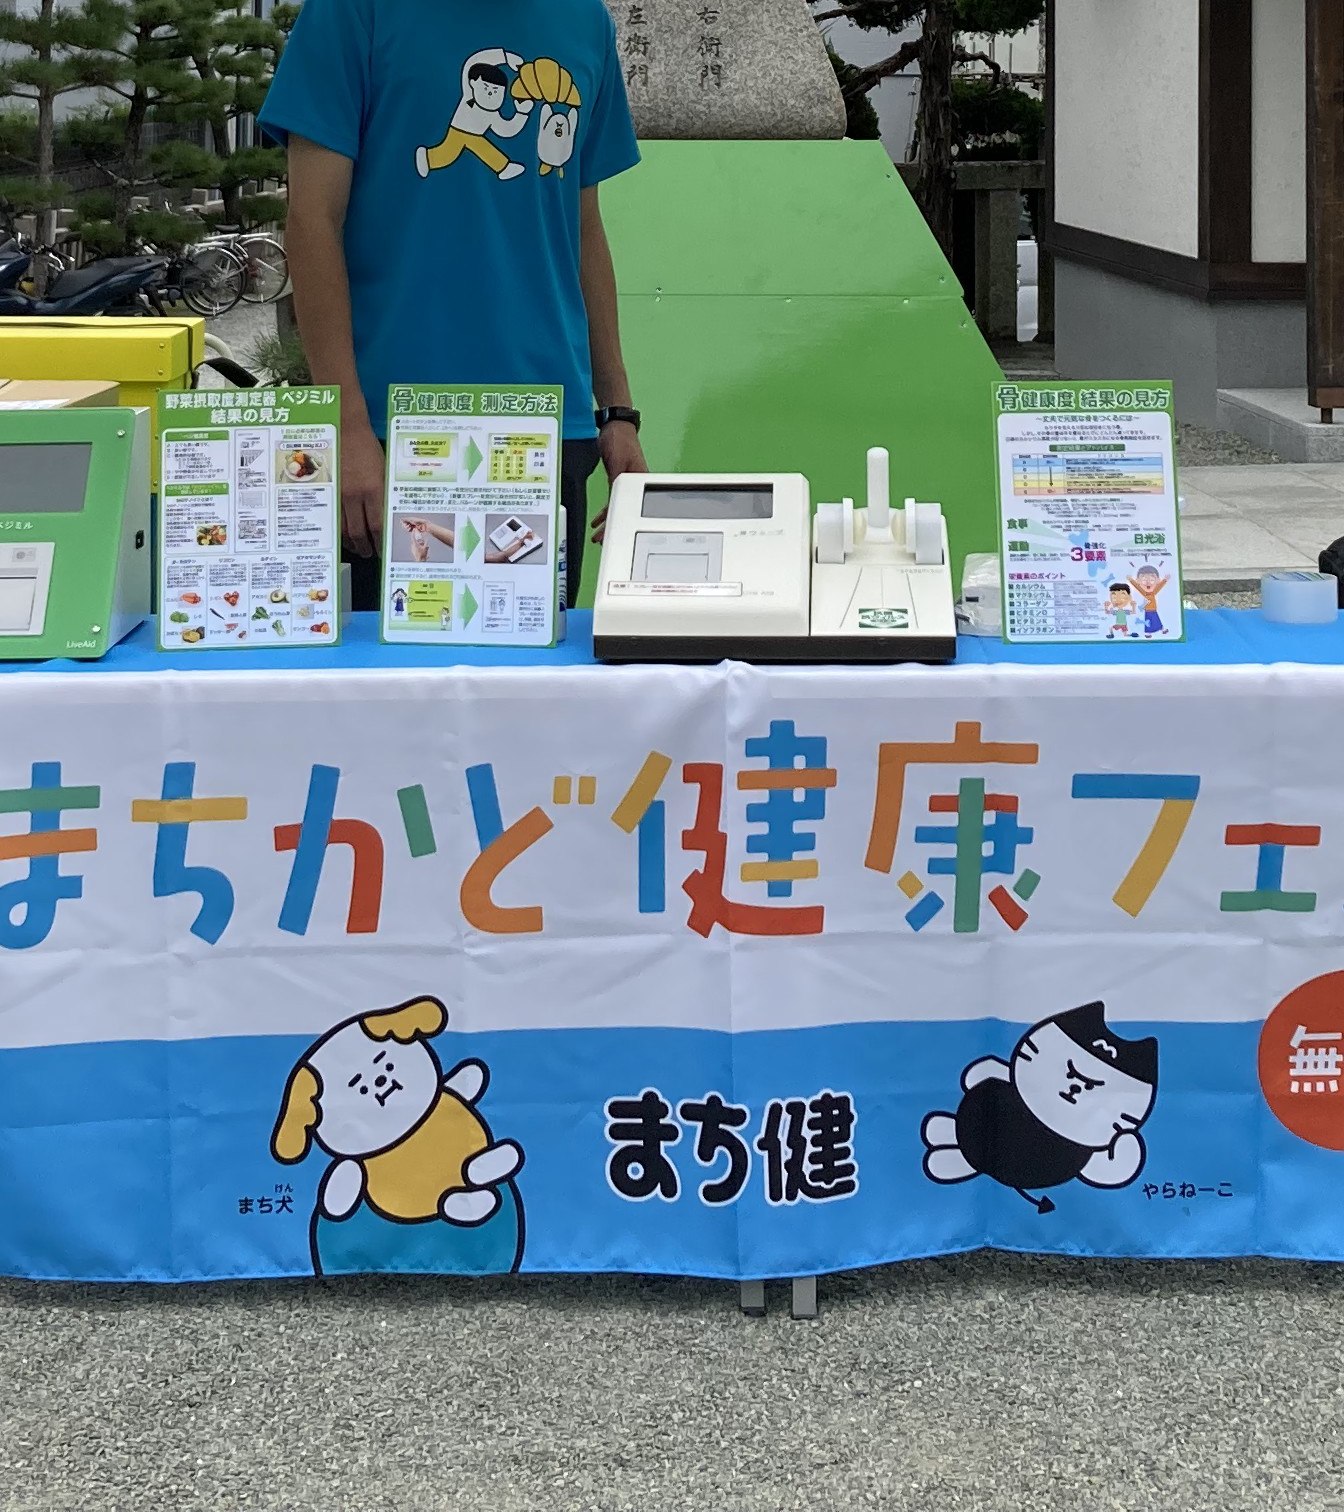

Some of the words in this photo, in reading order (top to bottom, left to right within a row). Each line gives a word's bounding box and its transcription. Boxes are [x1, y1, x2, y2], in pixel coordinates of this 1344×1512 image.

[165, 391, 277, 409] 野菜摂取度測定器
[281, 389, 335, 405] ベジミル
[393, 387, 474, 413] 骨健康度
[481, 392, 558, 413] 測定方法
[997, 385, 1075, 410] 骨健康度
[1080, 389, 1171, 410] 結果の見方
[210, 407, 291, 424] 結果の見方
[1007, 518, 1028, 530] 食事
[66, 640, 96, 648] LiveAid
[605, 1088, 859, 1206] まち健
[274, 1184, 294, 1194] けん
[1142, 1181, 1233, 1201] やらねーこ
[237, 1196, 294, 1215] まち犬
